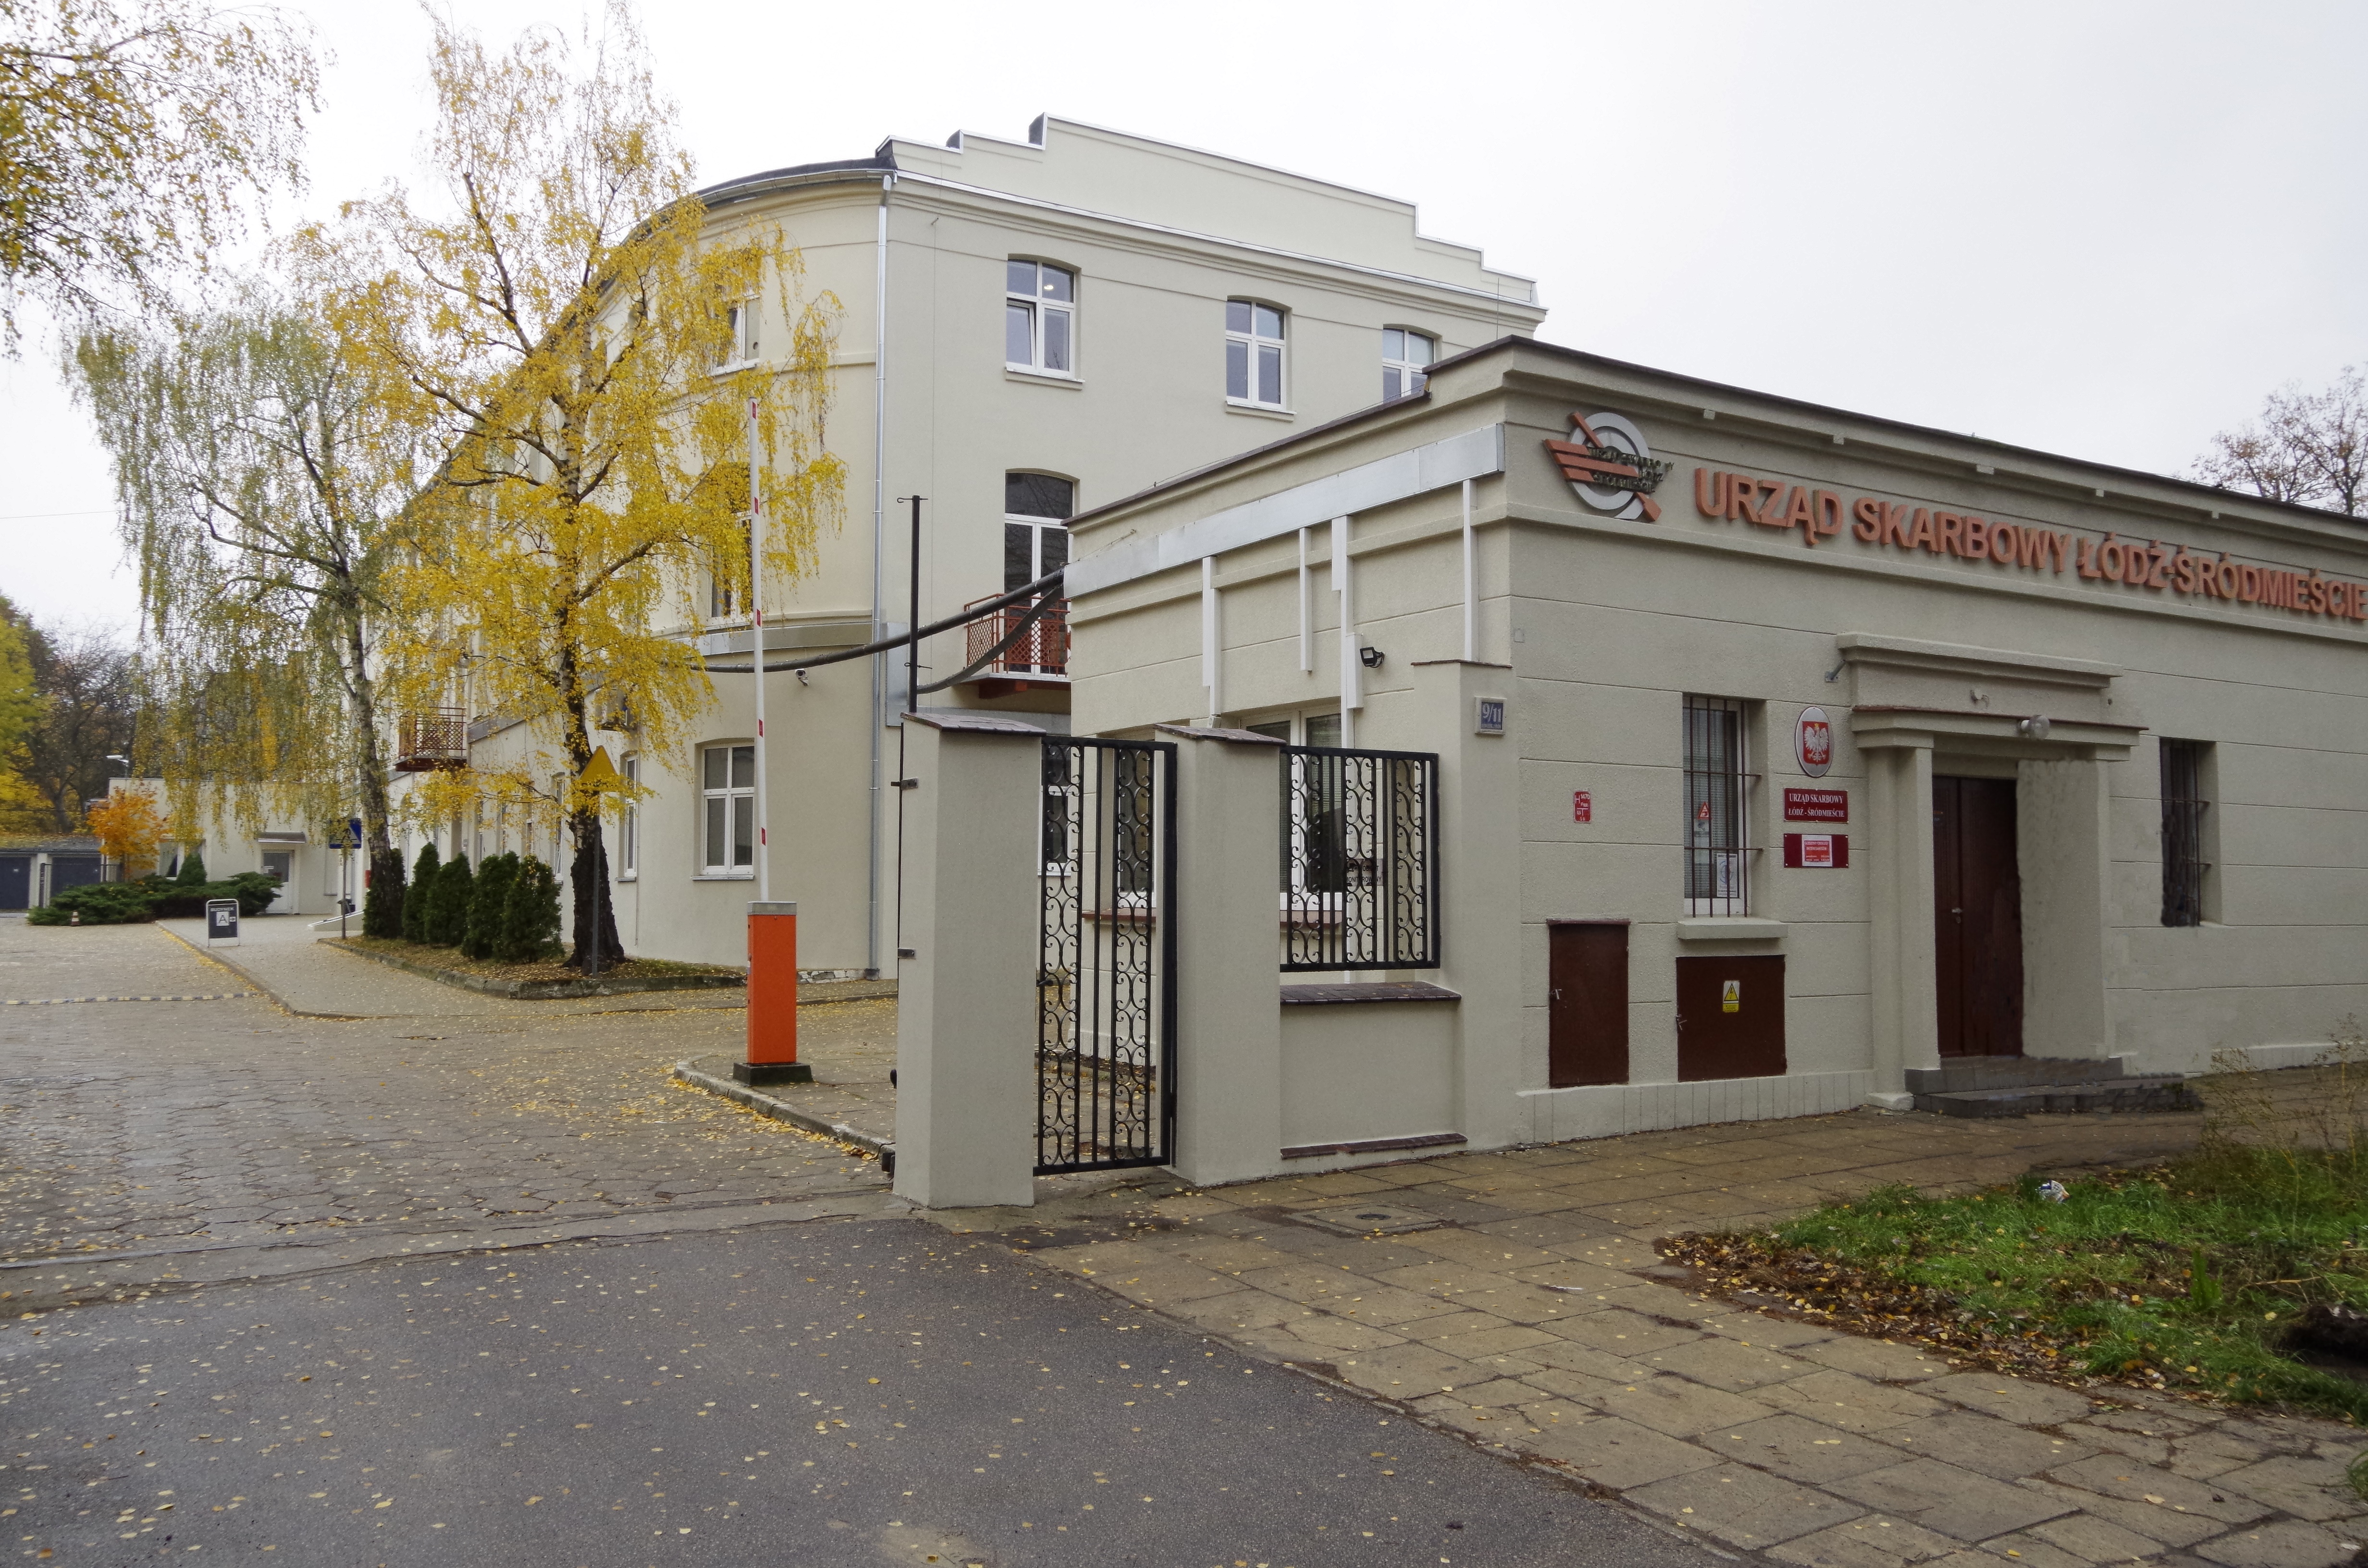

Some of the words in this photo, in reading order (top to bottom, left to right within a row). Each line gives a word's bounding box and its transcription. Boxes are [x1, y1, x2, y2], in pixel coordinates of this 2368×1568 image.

[1695, 468, 1843, 545] URZĄD
[1852, 497, 2072, 573] SKARBOWY
[1482, 703, 1501, 722] 9/11
[1789, 793, 1809, 804] URZĄD
[1811, 794, 1843, 804] SKARBOWY
[1788, 807, 1803, 816] ŁÓDŹ
[1807, 807, 1844, 817] ŚRÓDMIEŚCIE
[219, 915, 227, 923] A
